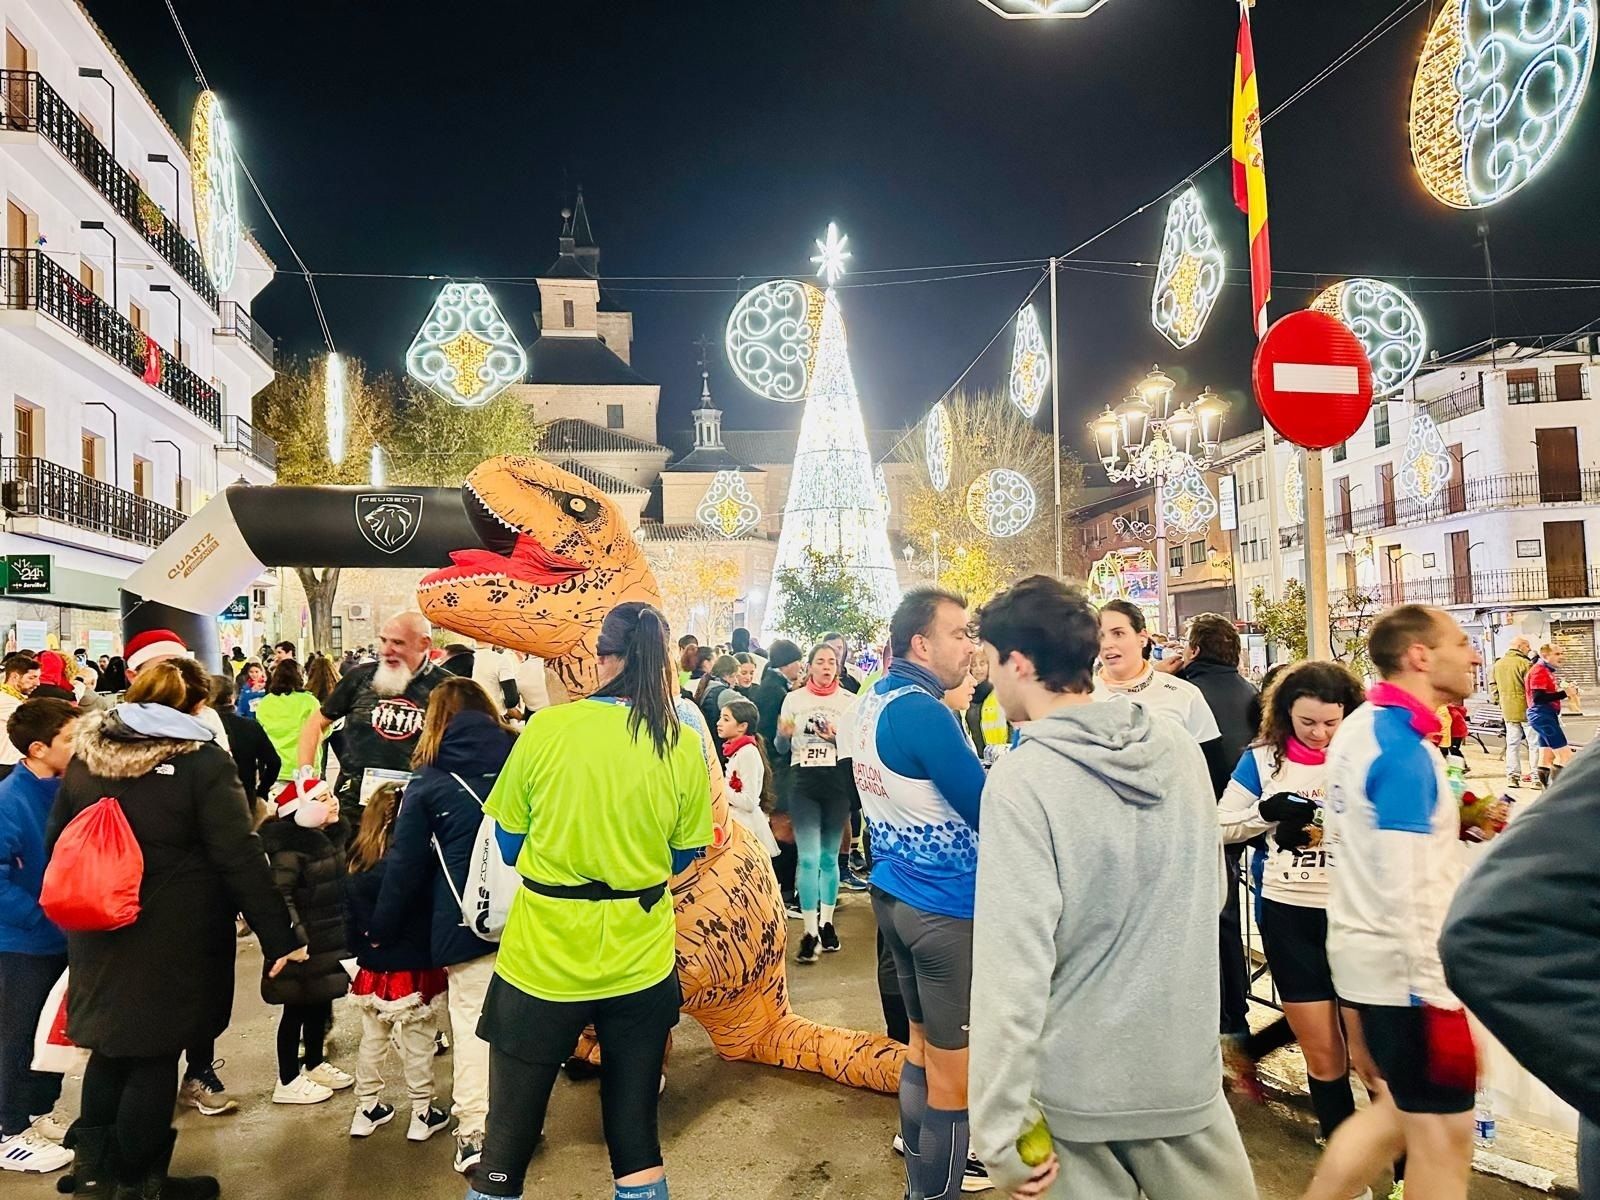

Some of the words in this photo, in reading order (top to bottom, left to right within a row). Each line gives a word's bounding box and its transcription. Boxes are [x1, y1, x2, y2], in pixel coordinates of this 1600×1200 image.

[361, 496, 418, 504] PEUGEOT
[167, 532, 214, 580] QUARTZ
[21, 567, 45, 580] 24h
[807, 748, 828, 760] 214
